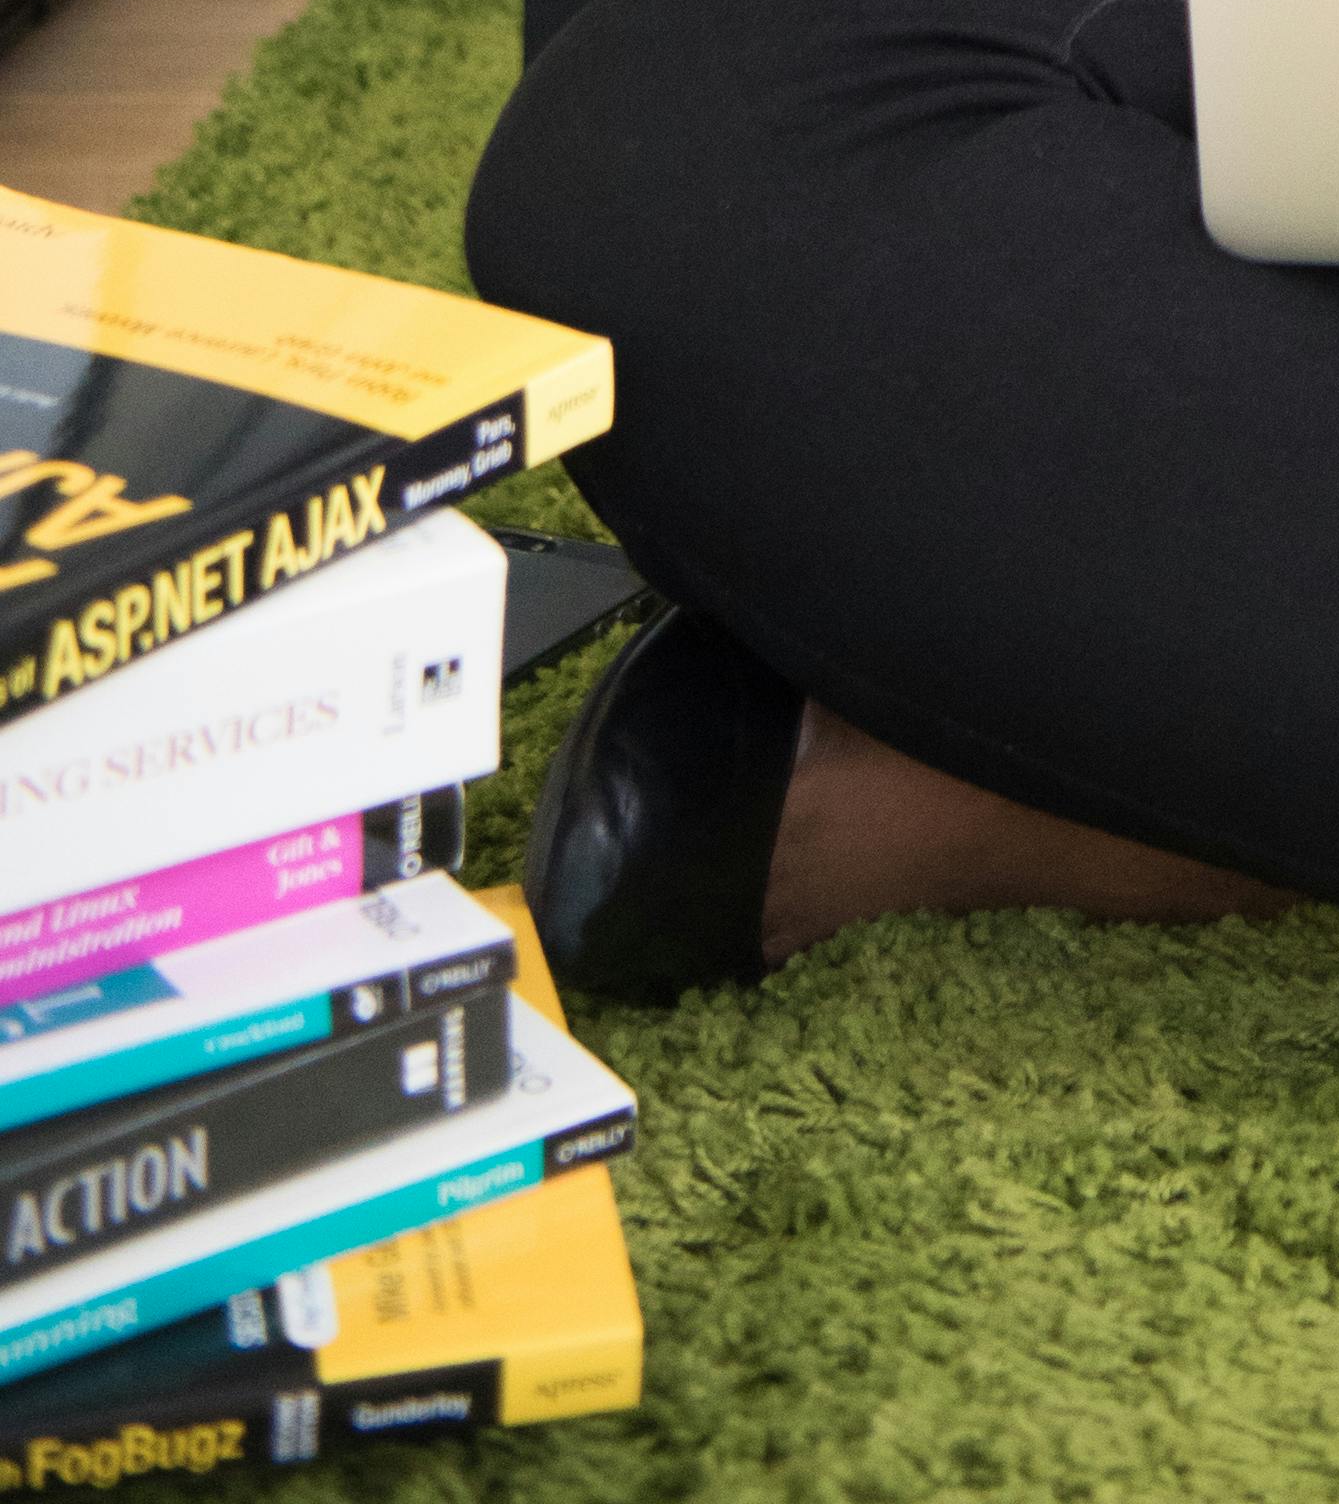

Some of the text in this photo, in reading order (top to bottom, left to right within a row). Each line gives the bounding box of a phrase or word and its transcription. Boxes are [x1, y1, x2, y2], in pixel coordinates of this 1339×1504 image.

[43, 529, 255, 700] ASP.NET
[259, 463, 389, 591] AJAX
[103, 691, 341, 788] SERVICES
[316, 825, 342, 852] &
[0, 905, 183, 983] ministration
[52, 886, 142, 935] Linux
[4, 1125, 209, 1267] ACTION
[26, 1418, 246, 1489] FogBugz
